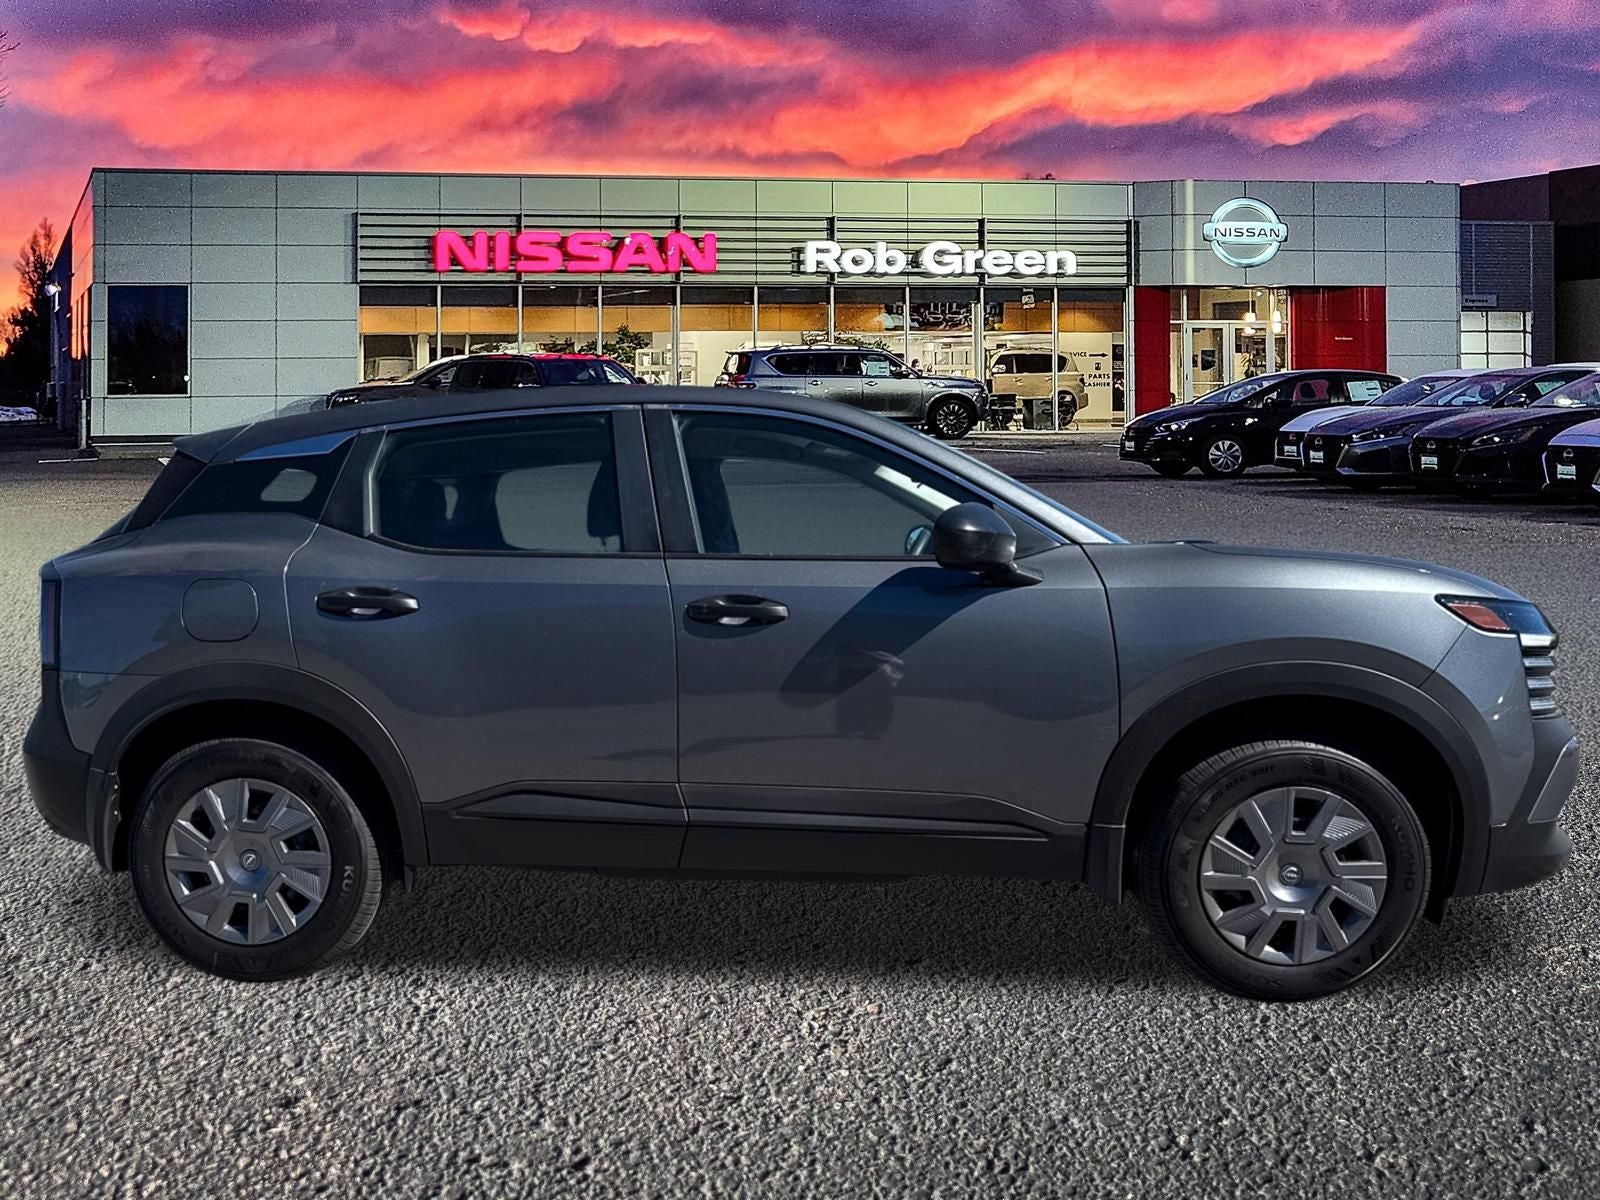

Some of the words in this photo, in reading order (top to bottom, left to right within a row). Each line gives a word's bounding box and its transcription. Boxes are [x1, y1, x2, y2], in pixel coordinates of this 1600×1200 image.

[1214, 227, 1280, 238] NISSAN
[434, 229, 718, 273] NISSAN
[804, 240, 907, 275] Rob
[921, 240, 1078, 276] Green
